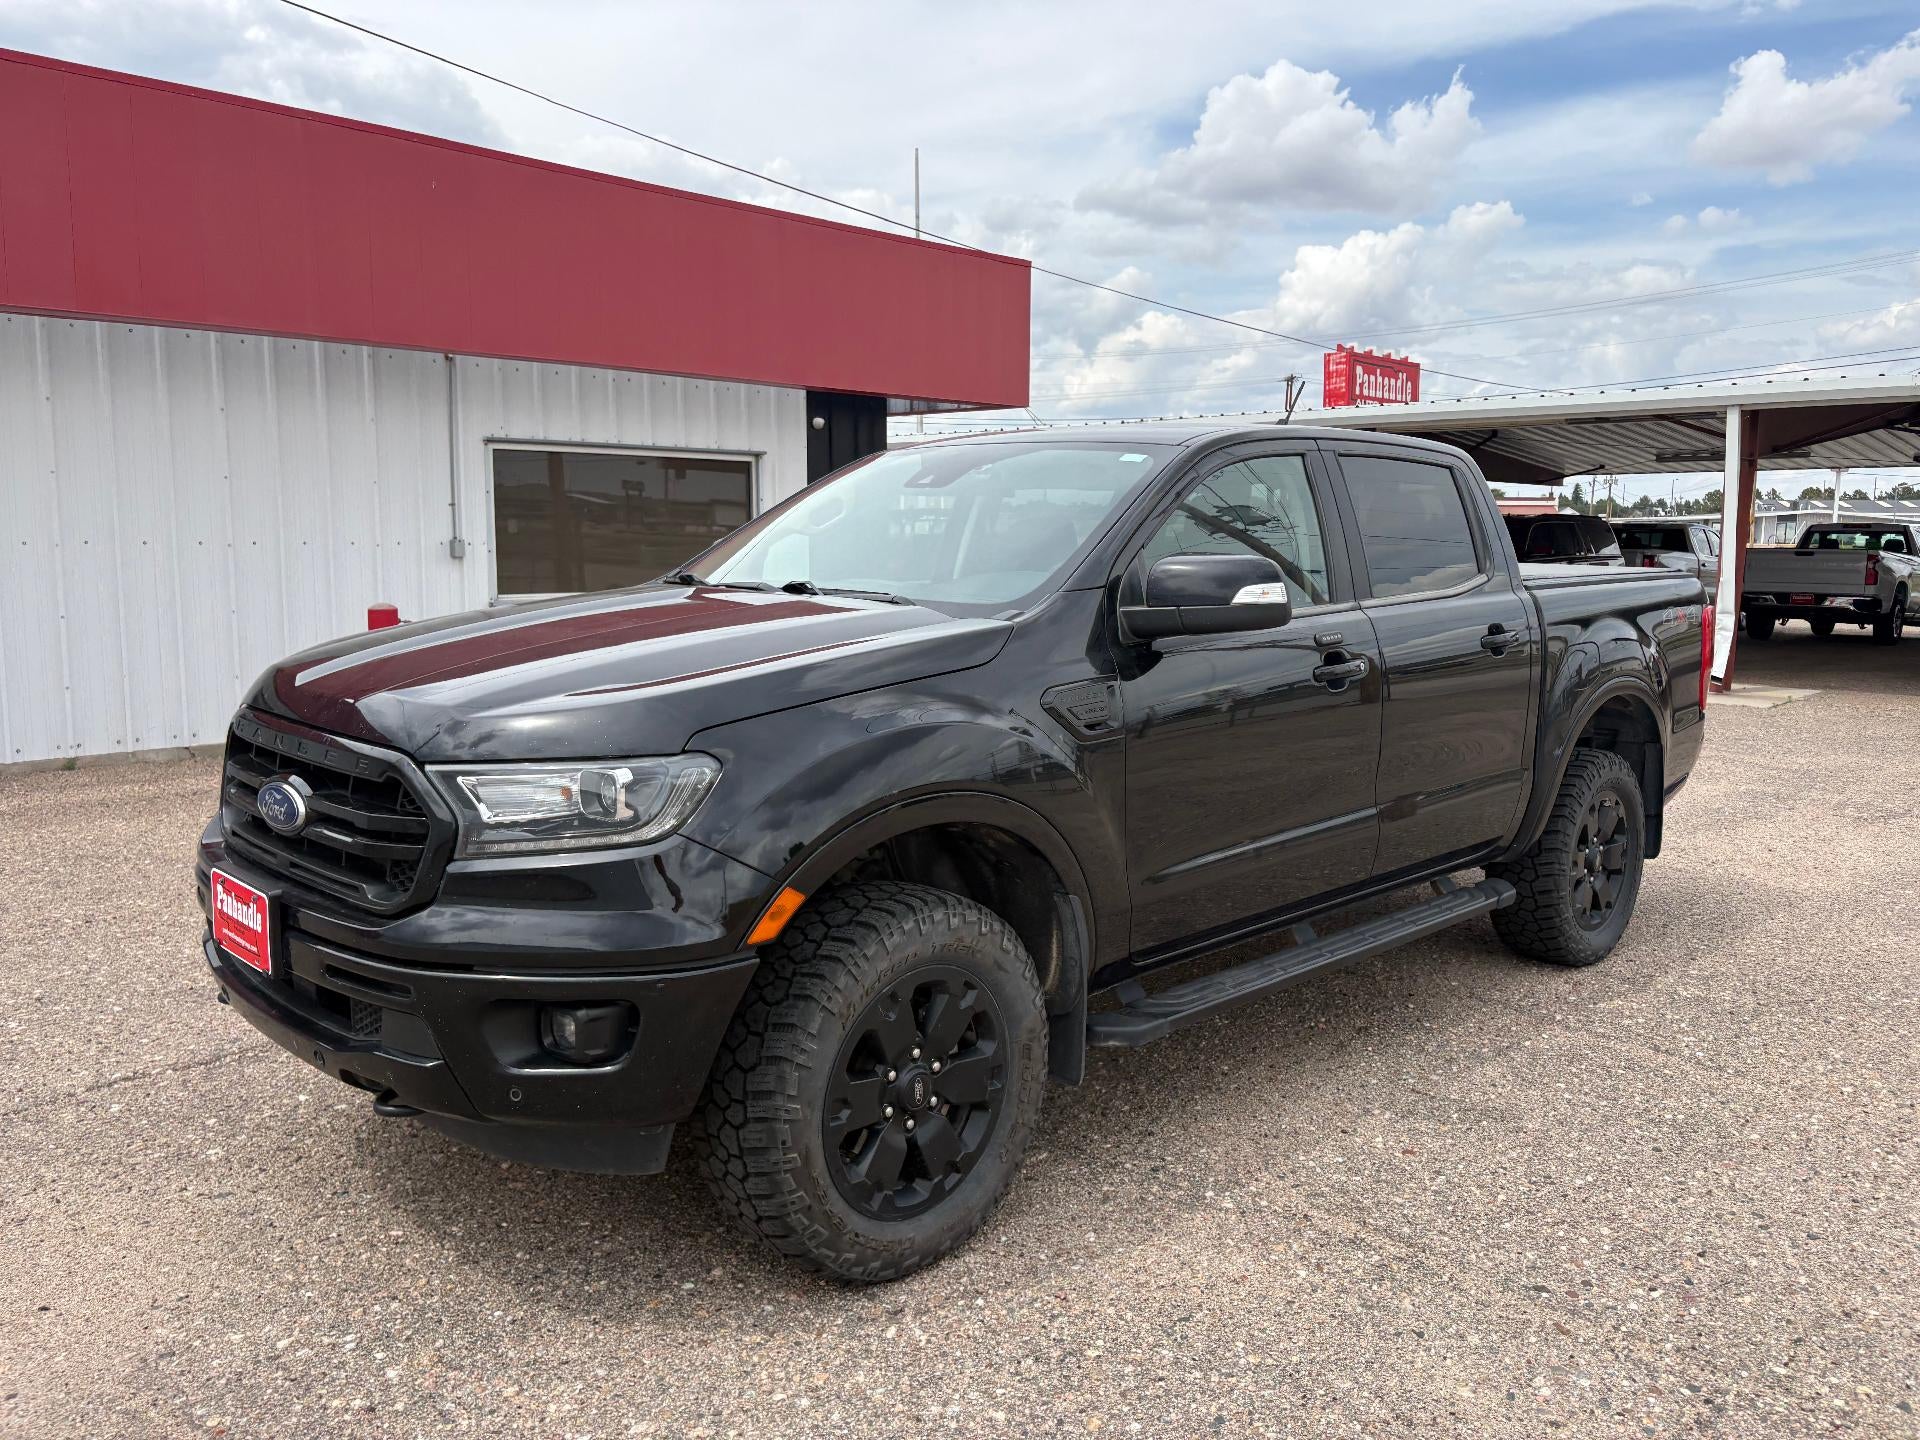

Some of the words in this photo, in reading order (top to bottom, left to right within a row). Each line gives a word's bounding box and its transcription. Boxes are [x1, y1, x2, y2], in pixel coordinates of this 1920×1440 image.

[1355, 365, 1412, 402] Panhandle
[261, 787, 288, 822] Ford
[216, 883, 262, 933] Panhandle
